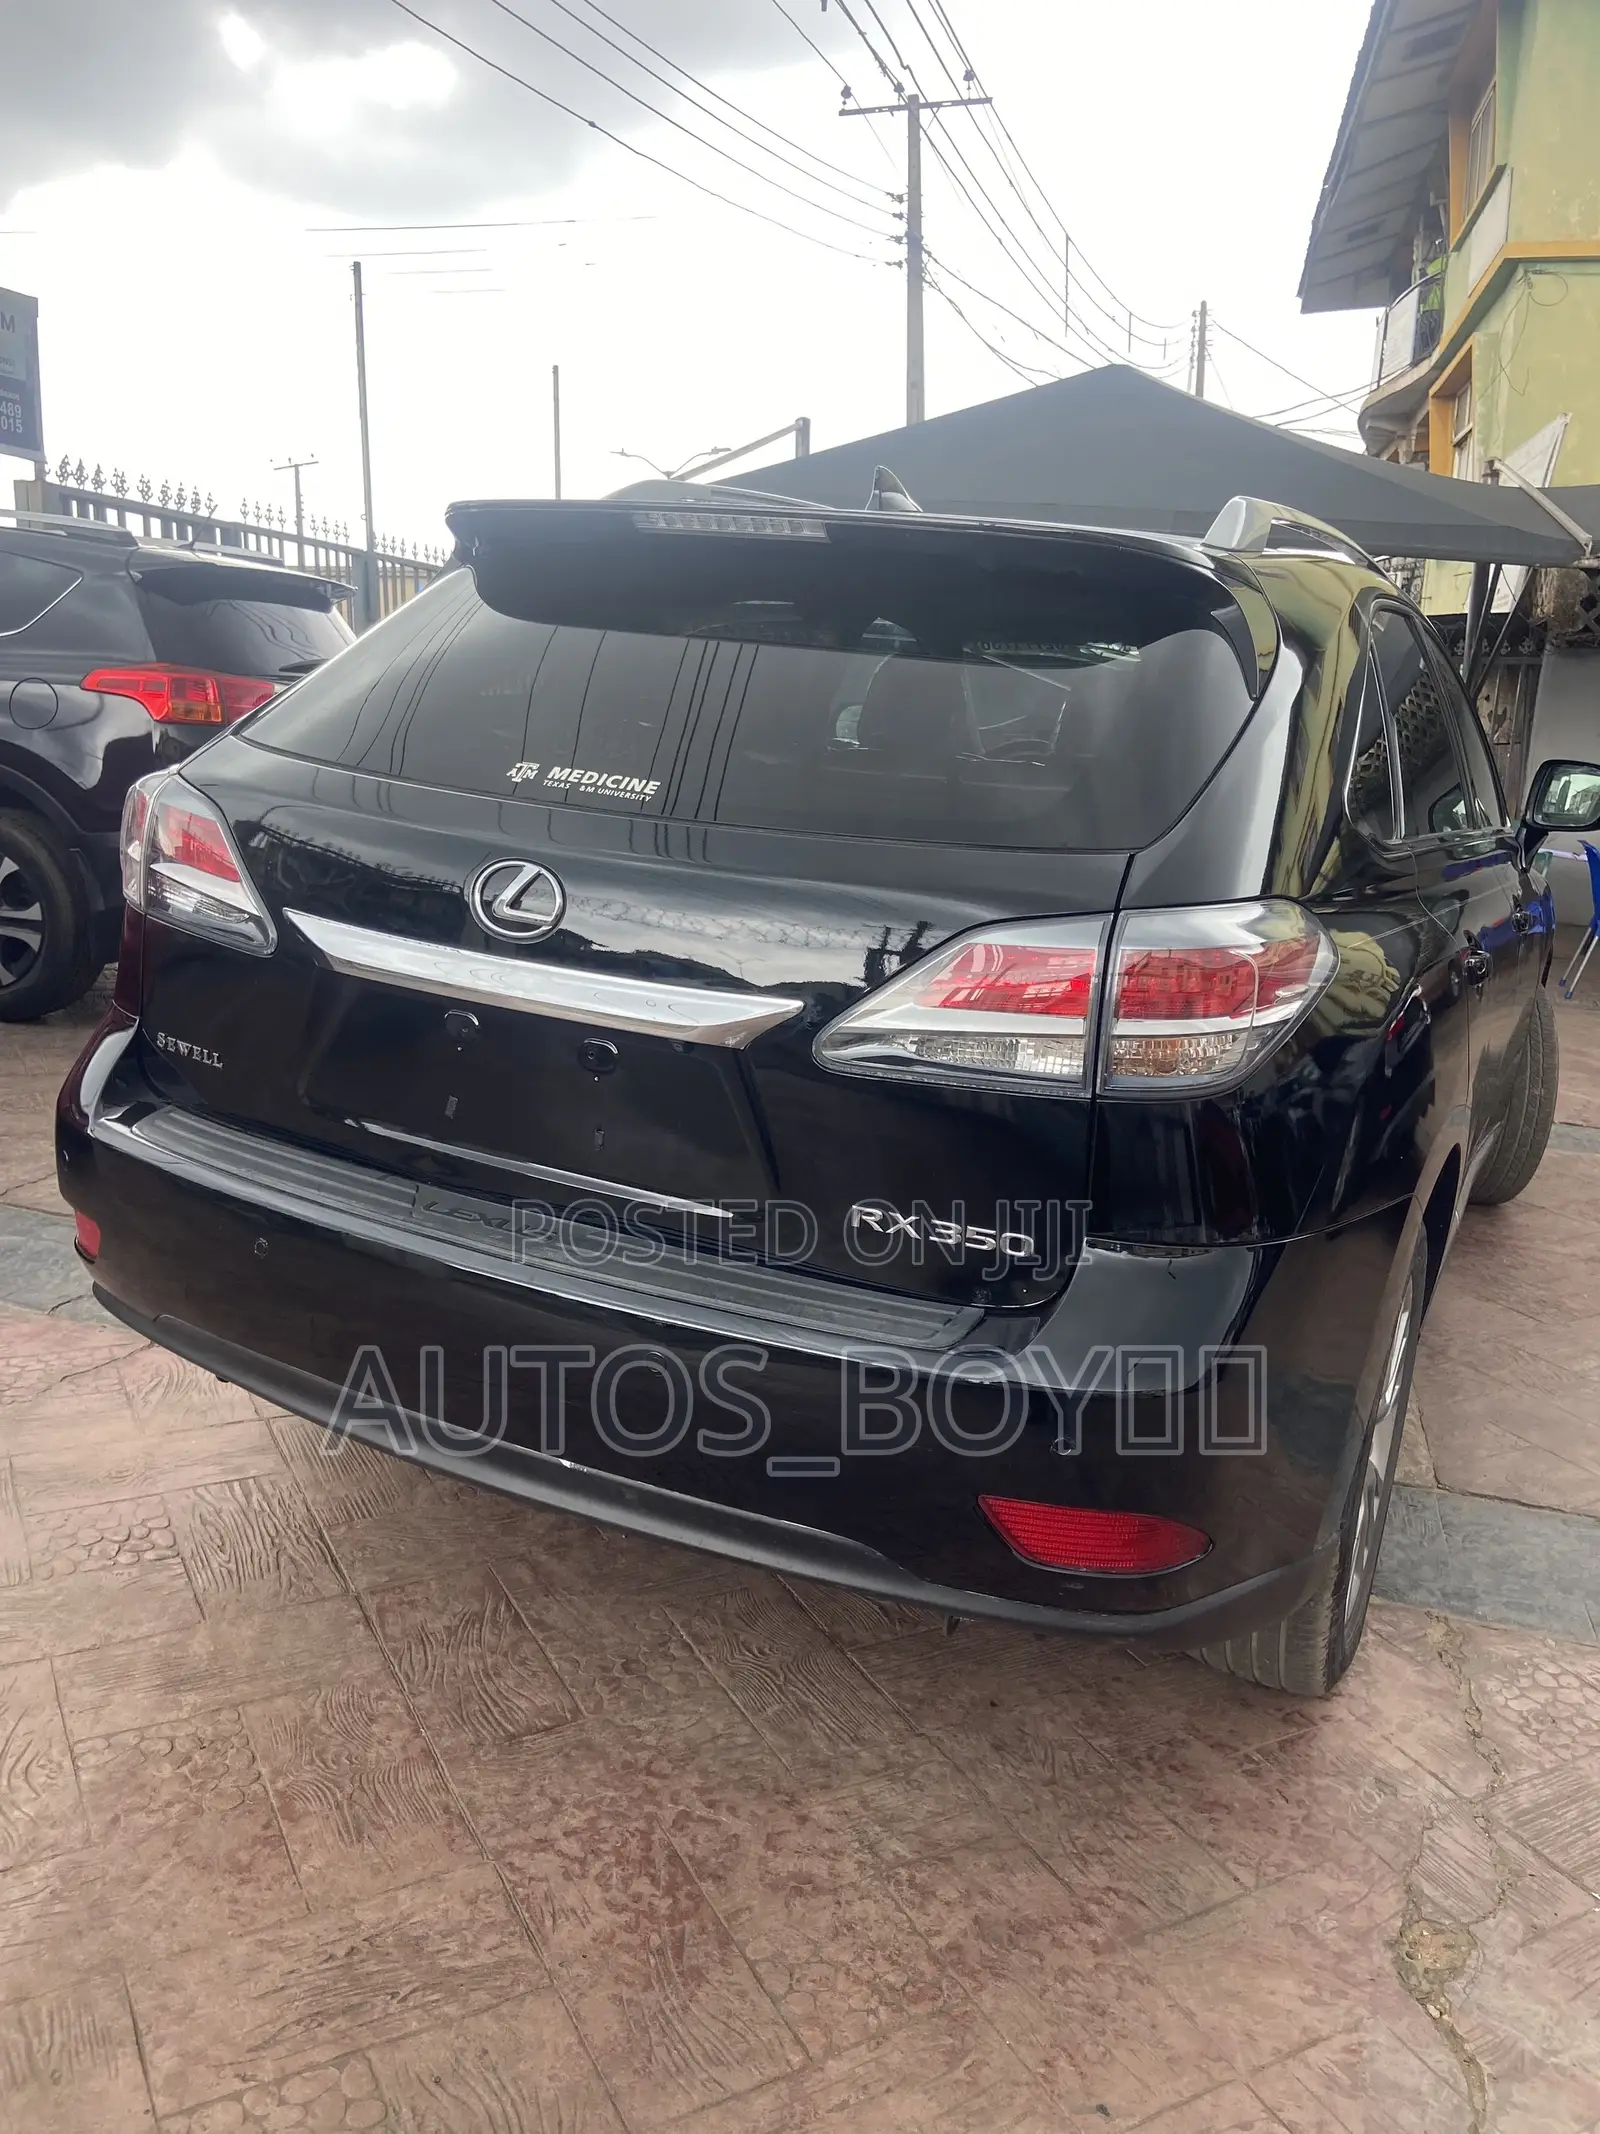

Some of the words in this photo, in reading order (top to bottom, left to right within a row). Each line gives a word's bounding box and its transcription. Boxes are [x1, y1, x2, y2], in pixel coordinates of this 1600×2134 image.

[542, 779, 572, 790] TEXAS
[597, 787, 653, 803] UNIVERSITY
[547, 766, 661, 795] MEDICINE
[156, 1031, 224, 1069] SEWELL
[851, 1204, 922, 1240] RX
[928, 1218, 1035, 1258] 350
